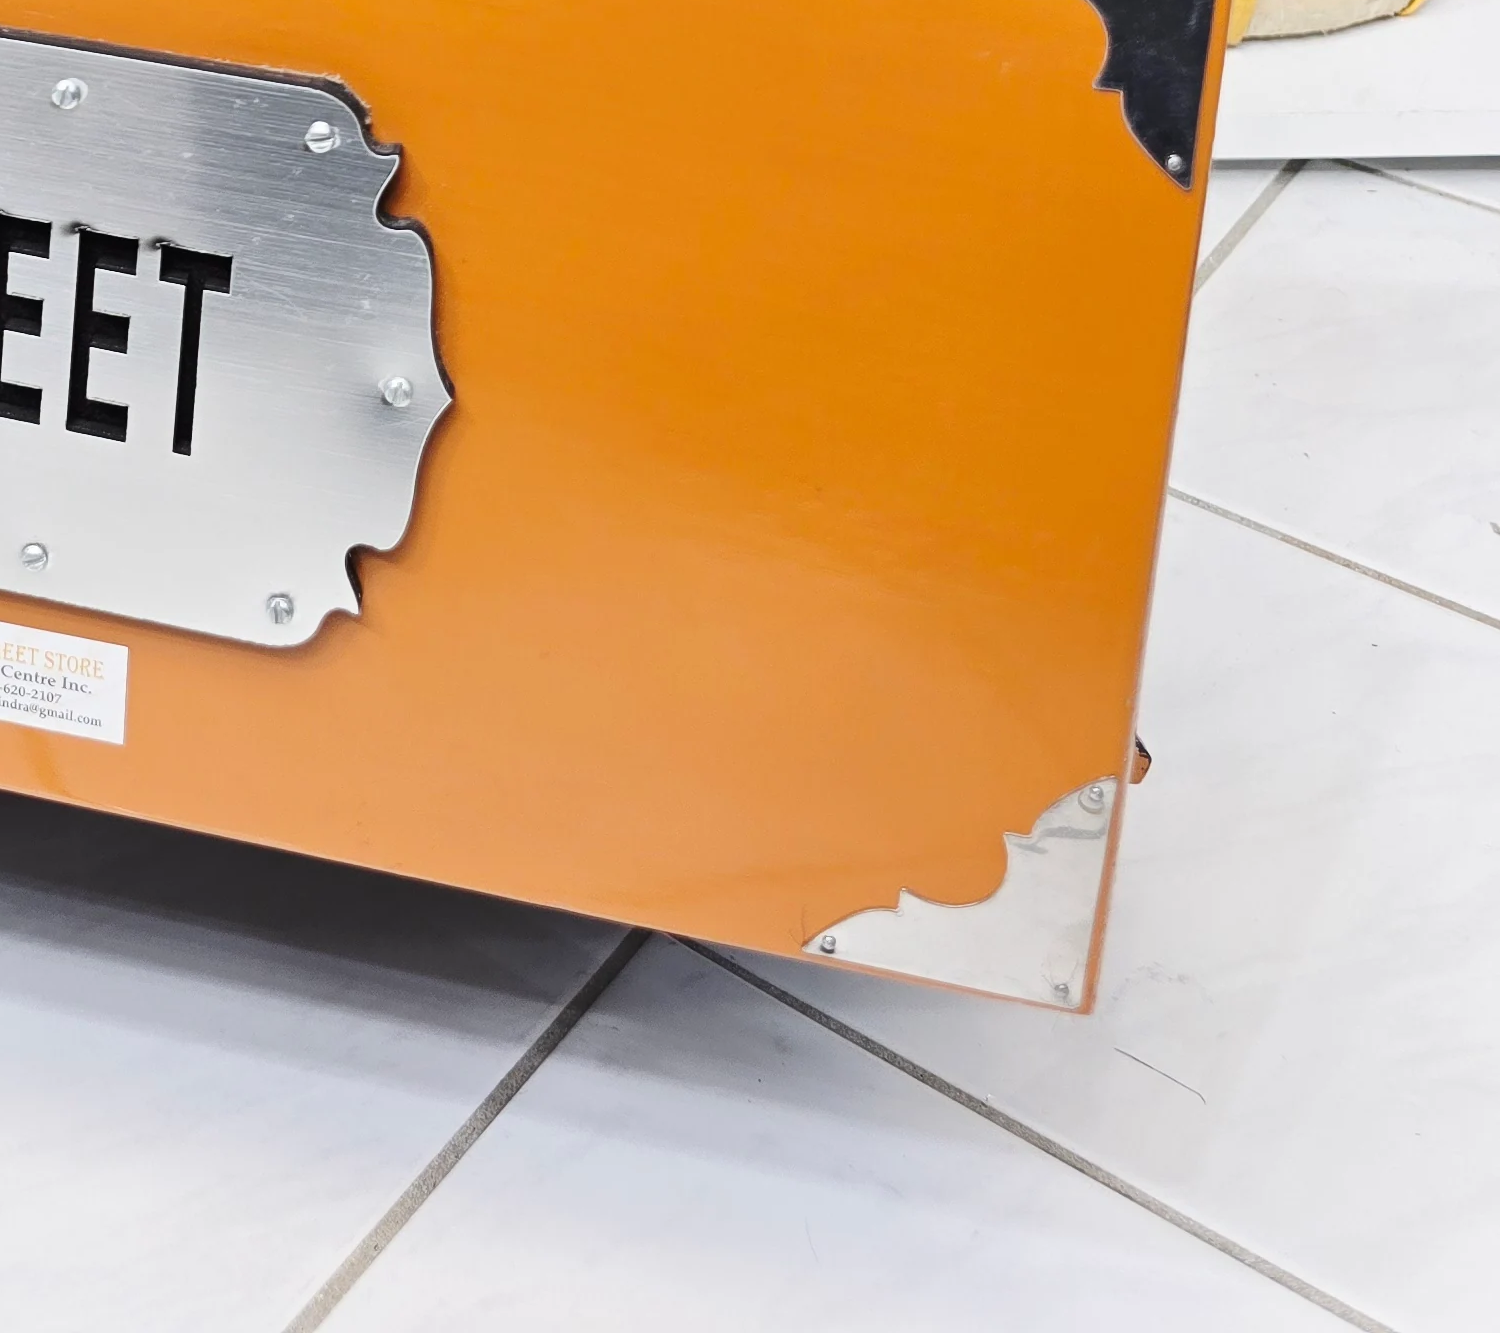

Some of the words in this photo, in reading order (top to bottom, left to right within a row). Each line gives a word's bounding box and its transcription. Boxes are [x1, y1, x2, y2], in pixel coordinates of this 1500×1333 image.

[0, 665, 56, 687] Centre
[62, 676, 92, 695] Inc.
[44, 651, 105, 680] STORE
